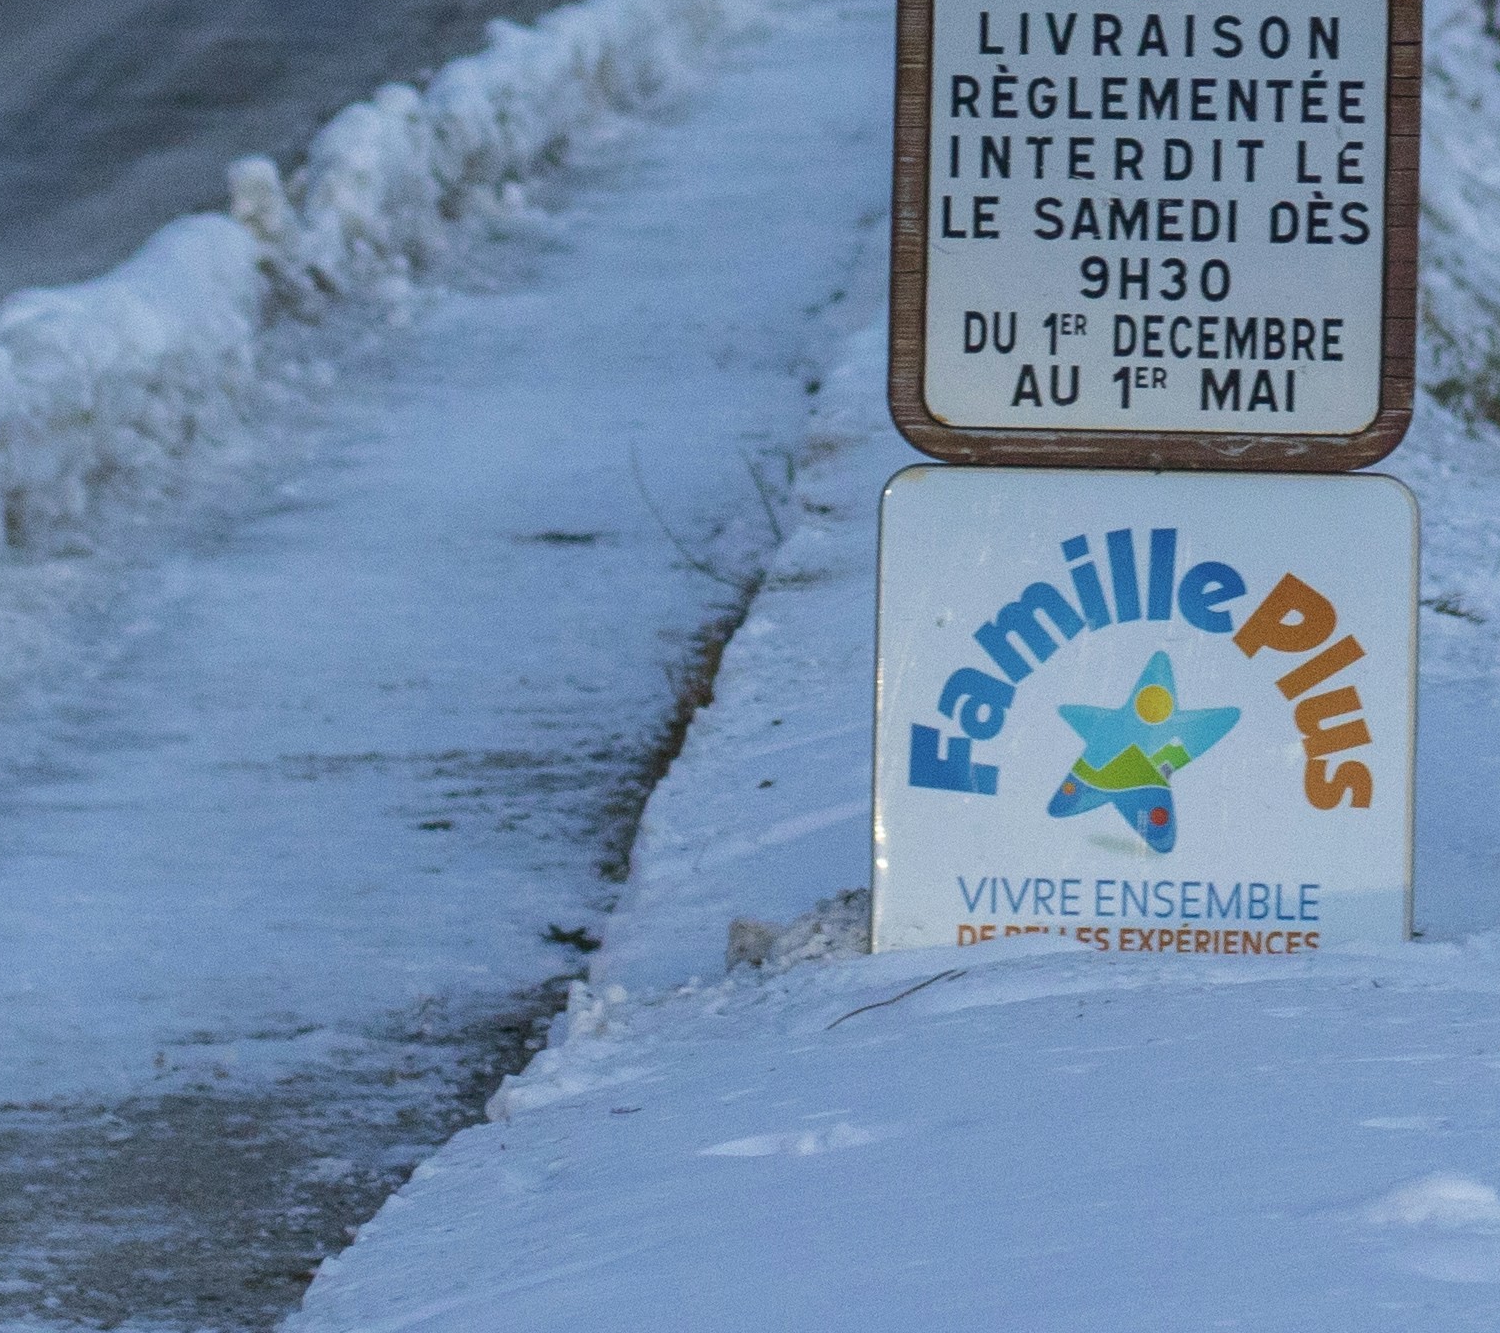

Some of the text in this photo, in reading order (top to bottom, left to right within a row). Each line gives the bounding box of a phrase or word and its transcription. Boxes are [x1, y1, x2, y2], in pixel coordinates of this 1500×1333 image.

[980, 11, 1341, 60] LIVRAISON
[951, 65, 1365, 124] RÈGLEMENTÉE
[950, 135, 1365, 185] INTERDIT LE
[941, 190, 1370, 245] LE SAMEDI DÈS
[1080, 256, 1232, 301] 9H30
[964, 311, 1344, 362] DU 1ER DECEMBRE
[1011, 365, 1296, 412] AU 1ER MAI
[909, 528, 1374, 810] Famille Plus
[957, 876, 1321, 921] VIVRE ENSEMBLE
[1119, 923, 1320, 955] EXPÉRIENCES
